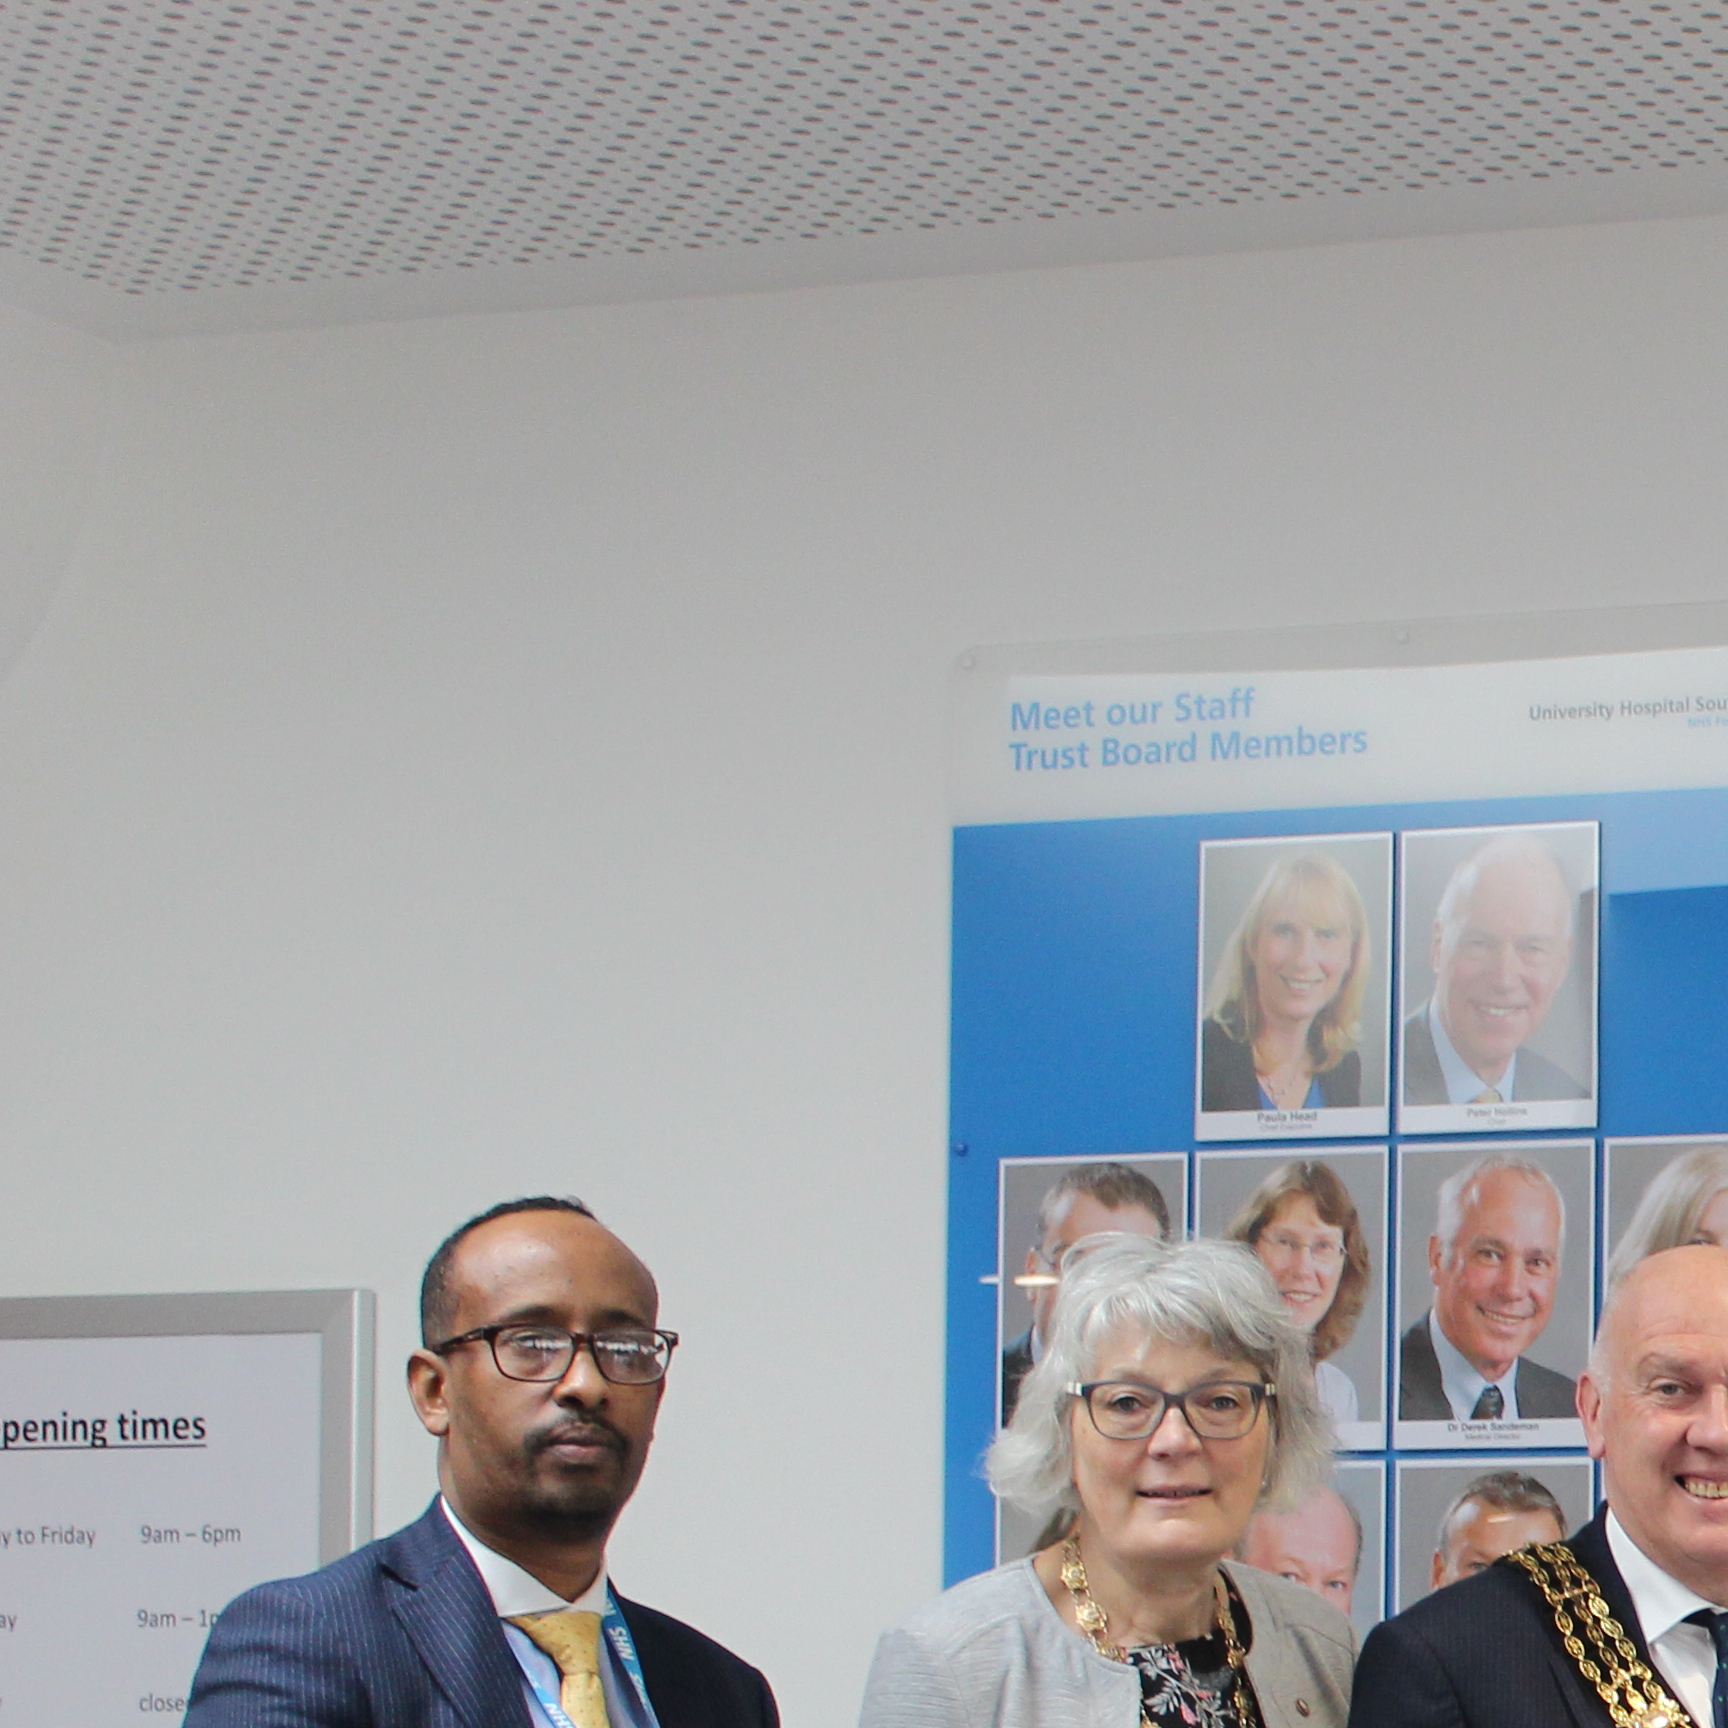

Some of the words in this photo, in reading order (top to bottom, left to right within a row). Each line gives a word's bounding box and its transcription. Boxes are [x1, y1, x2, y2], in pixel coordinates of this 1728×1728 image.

[1010, 701, 1095, 731] Meet
[1106, 701, 1162, 725] our
[1174, 686, 1255, 723] Staff
[1530, 701, 1614, 721] University
[1620, 698, 1690, 716] Hospital
[1008, 741, 1090, 771] Trust
[1101, 731, 1198, 766] Board
[1210, 726, 1367, 761] Members
[1, 1410, 108, 1448] pening
[117, 1409, 206, 1441] times
[17, 1527, 35, 1544] to
[40, 1525, 96, 1547] Friday
[140, 1525, 180, 1544] 9am
[201, 1523, 241, 1545] 6pm
[137, 1608, 176, 1627] 9am
[139, 1693, 187, 1712] close
